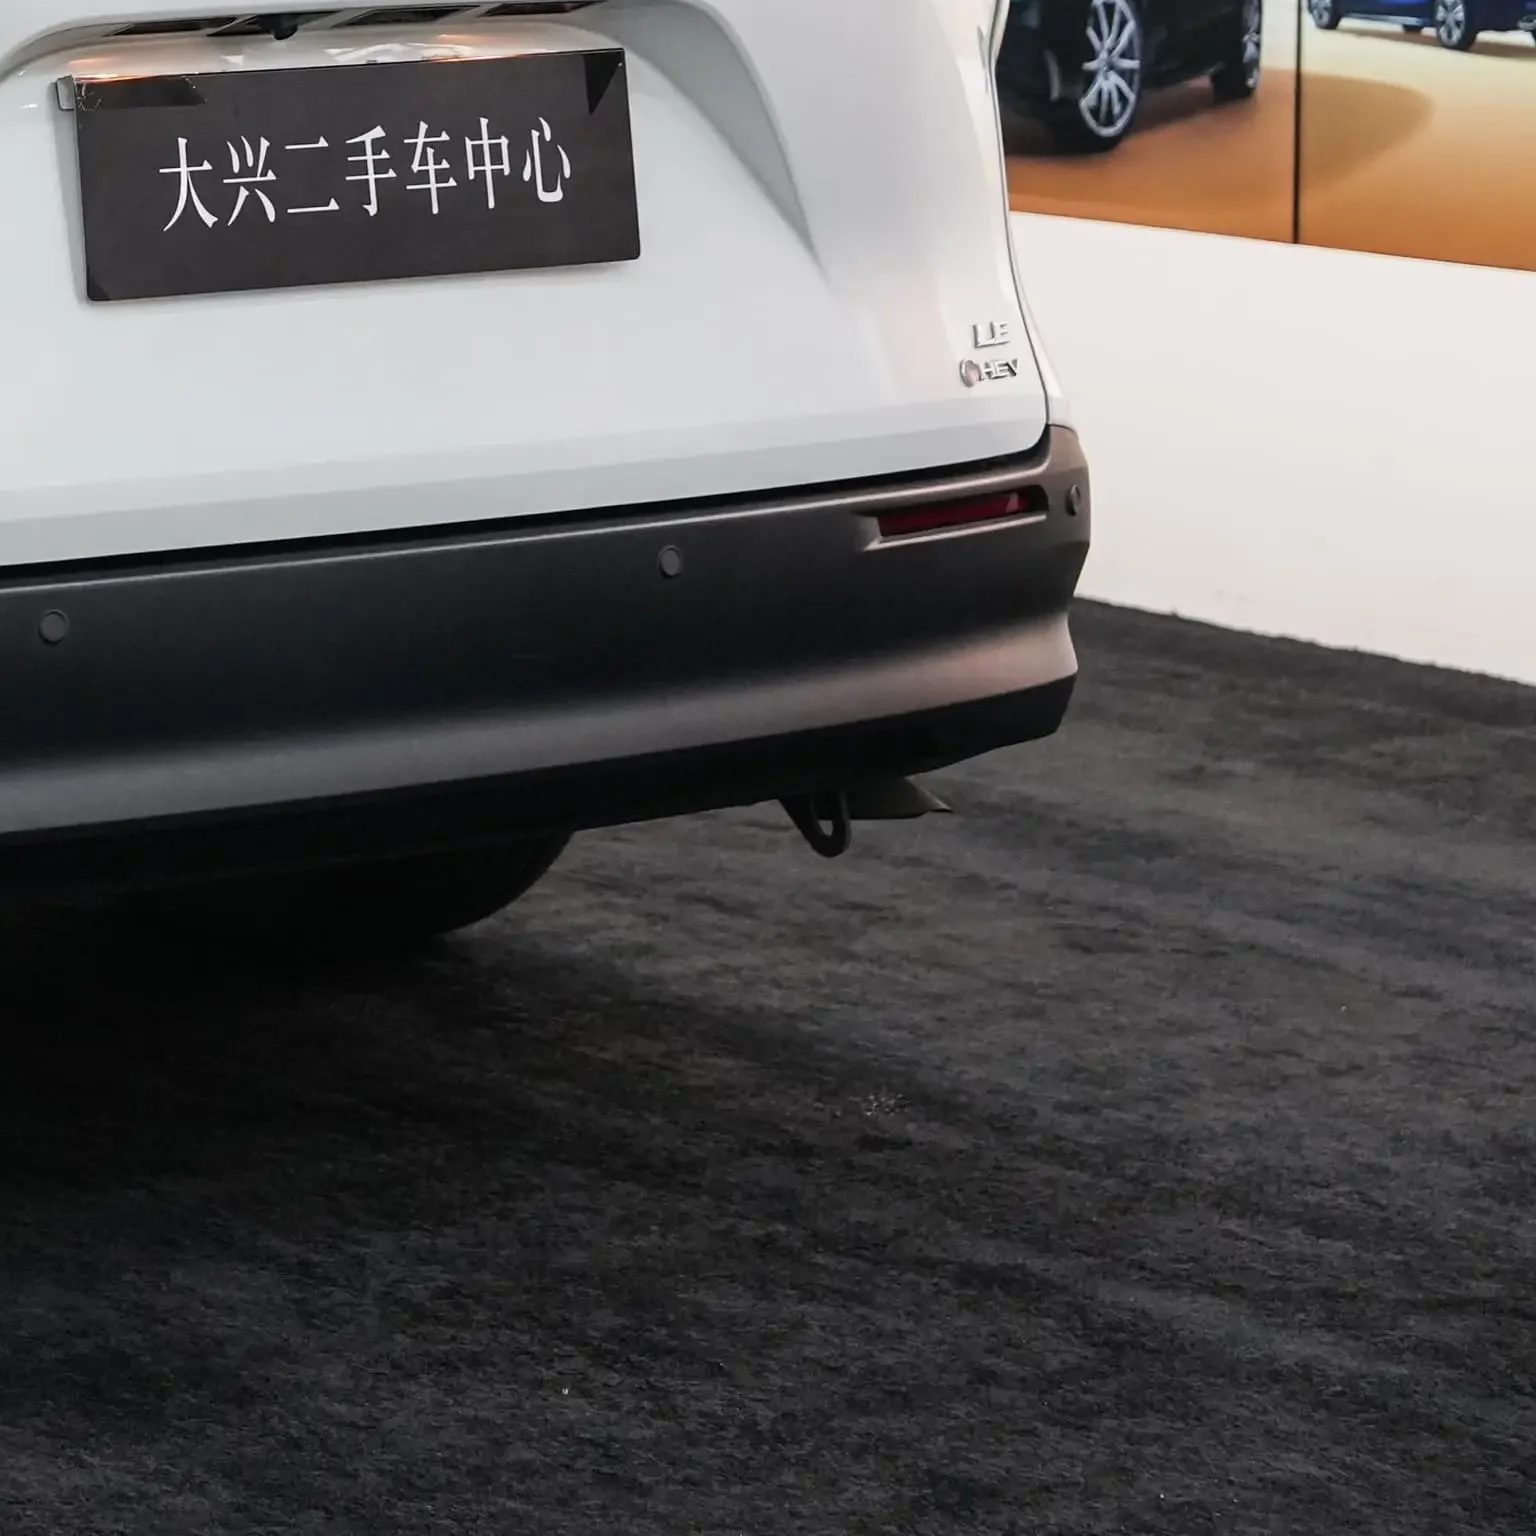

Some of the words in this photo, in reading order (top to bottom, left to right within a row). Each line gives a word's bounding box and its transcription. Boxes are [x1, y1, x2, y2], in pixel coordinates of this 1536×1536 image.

[157, 116, 573, 233] 大兴二手车中心
